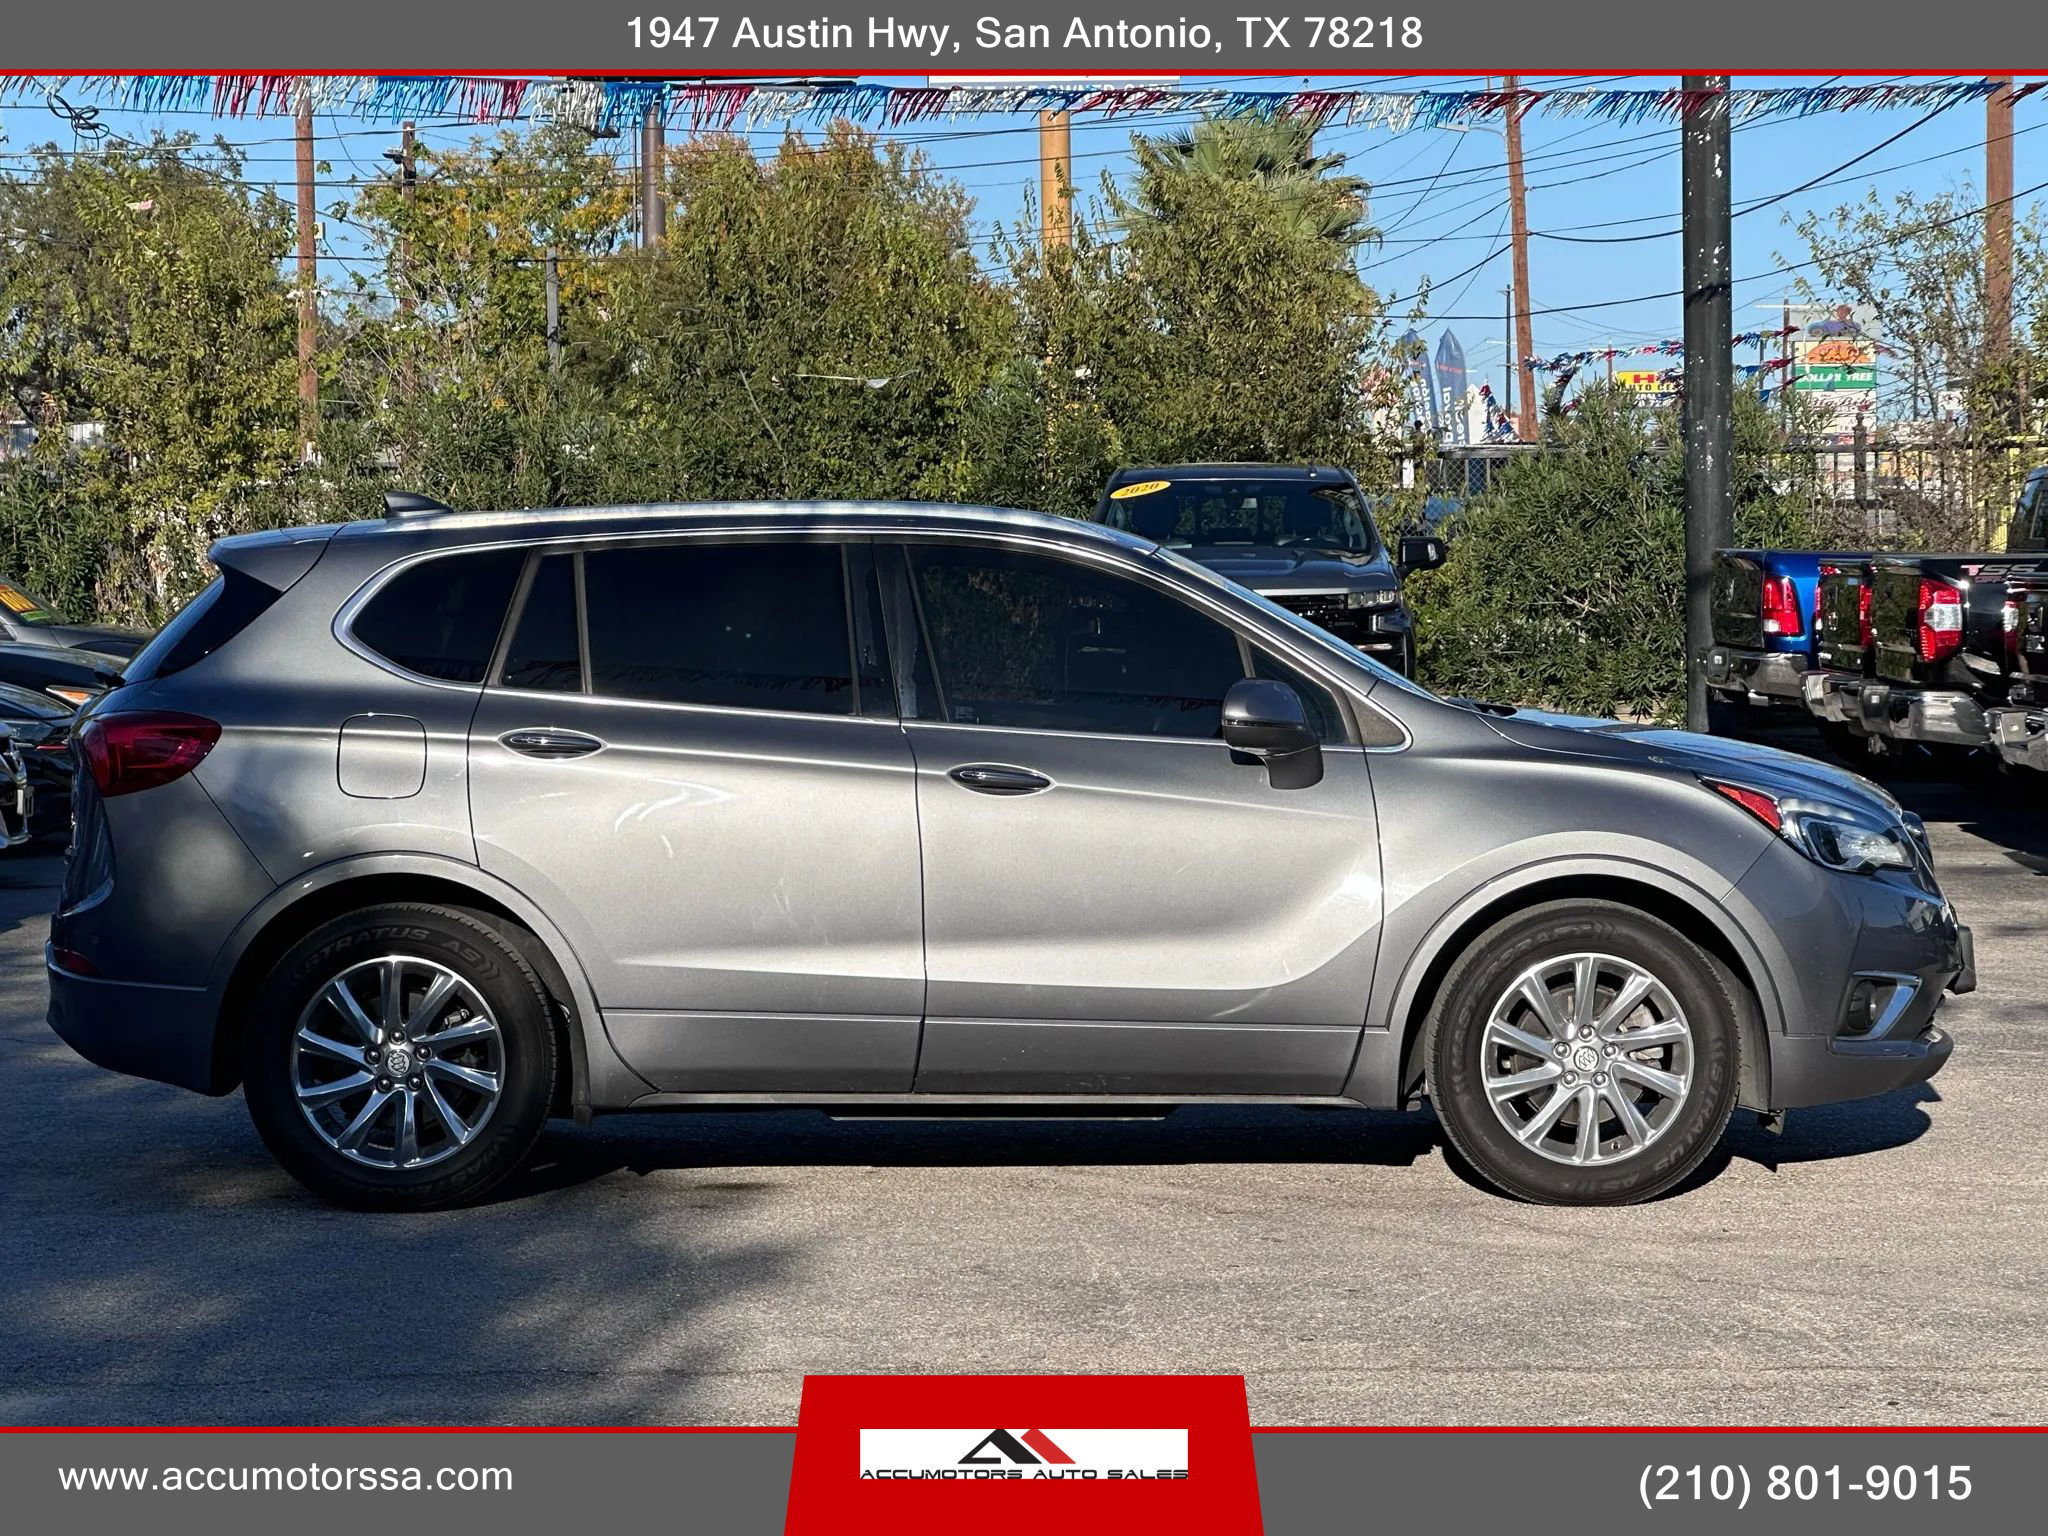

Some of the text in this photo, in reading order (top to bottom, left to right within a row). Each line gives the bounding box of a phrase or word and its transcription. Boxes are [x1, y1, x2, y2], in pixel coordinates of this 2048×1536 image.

[1846, 372, 1874, 382] TREE
[1120, 482, 1160, 497] 2020
[304, 926, 484, 973] STRATUS AS
[1651, 1062, 1726, 1172] STRATUS
